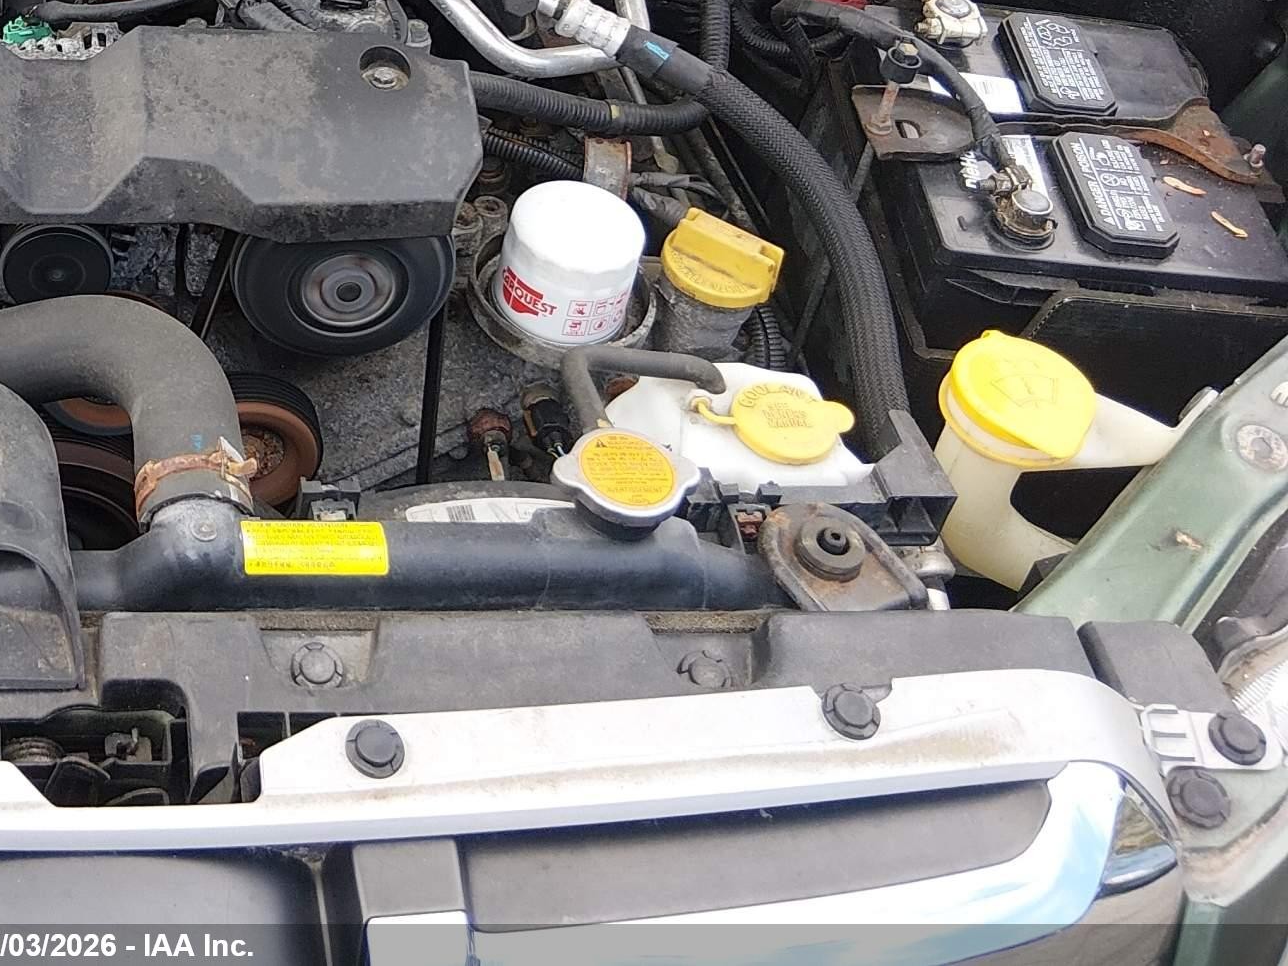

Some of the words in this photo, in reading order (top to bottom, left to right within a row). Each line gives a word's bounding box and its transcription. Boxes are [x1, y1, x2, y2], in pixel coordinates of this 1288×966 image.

[1070, 141, 1093, 174] POISON
[1087, 180, 1113, 216] DANGER
[504, 274, 558, 316] ARQUEST
